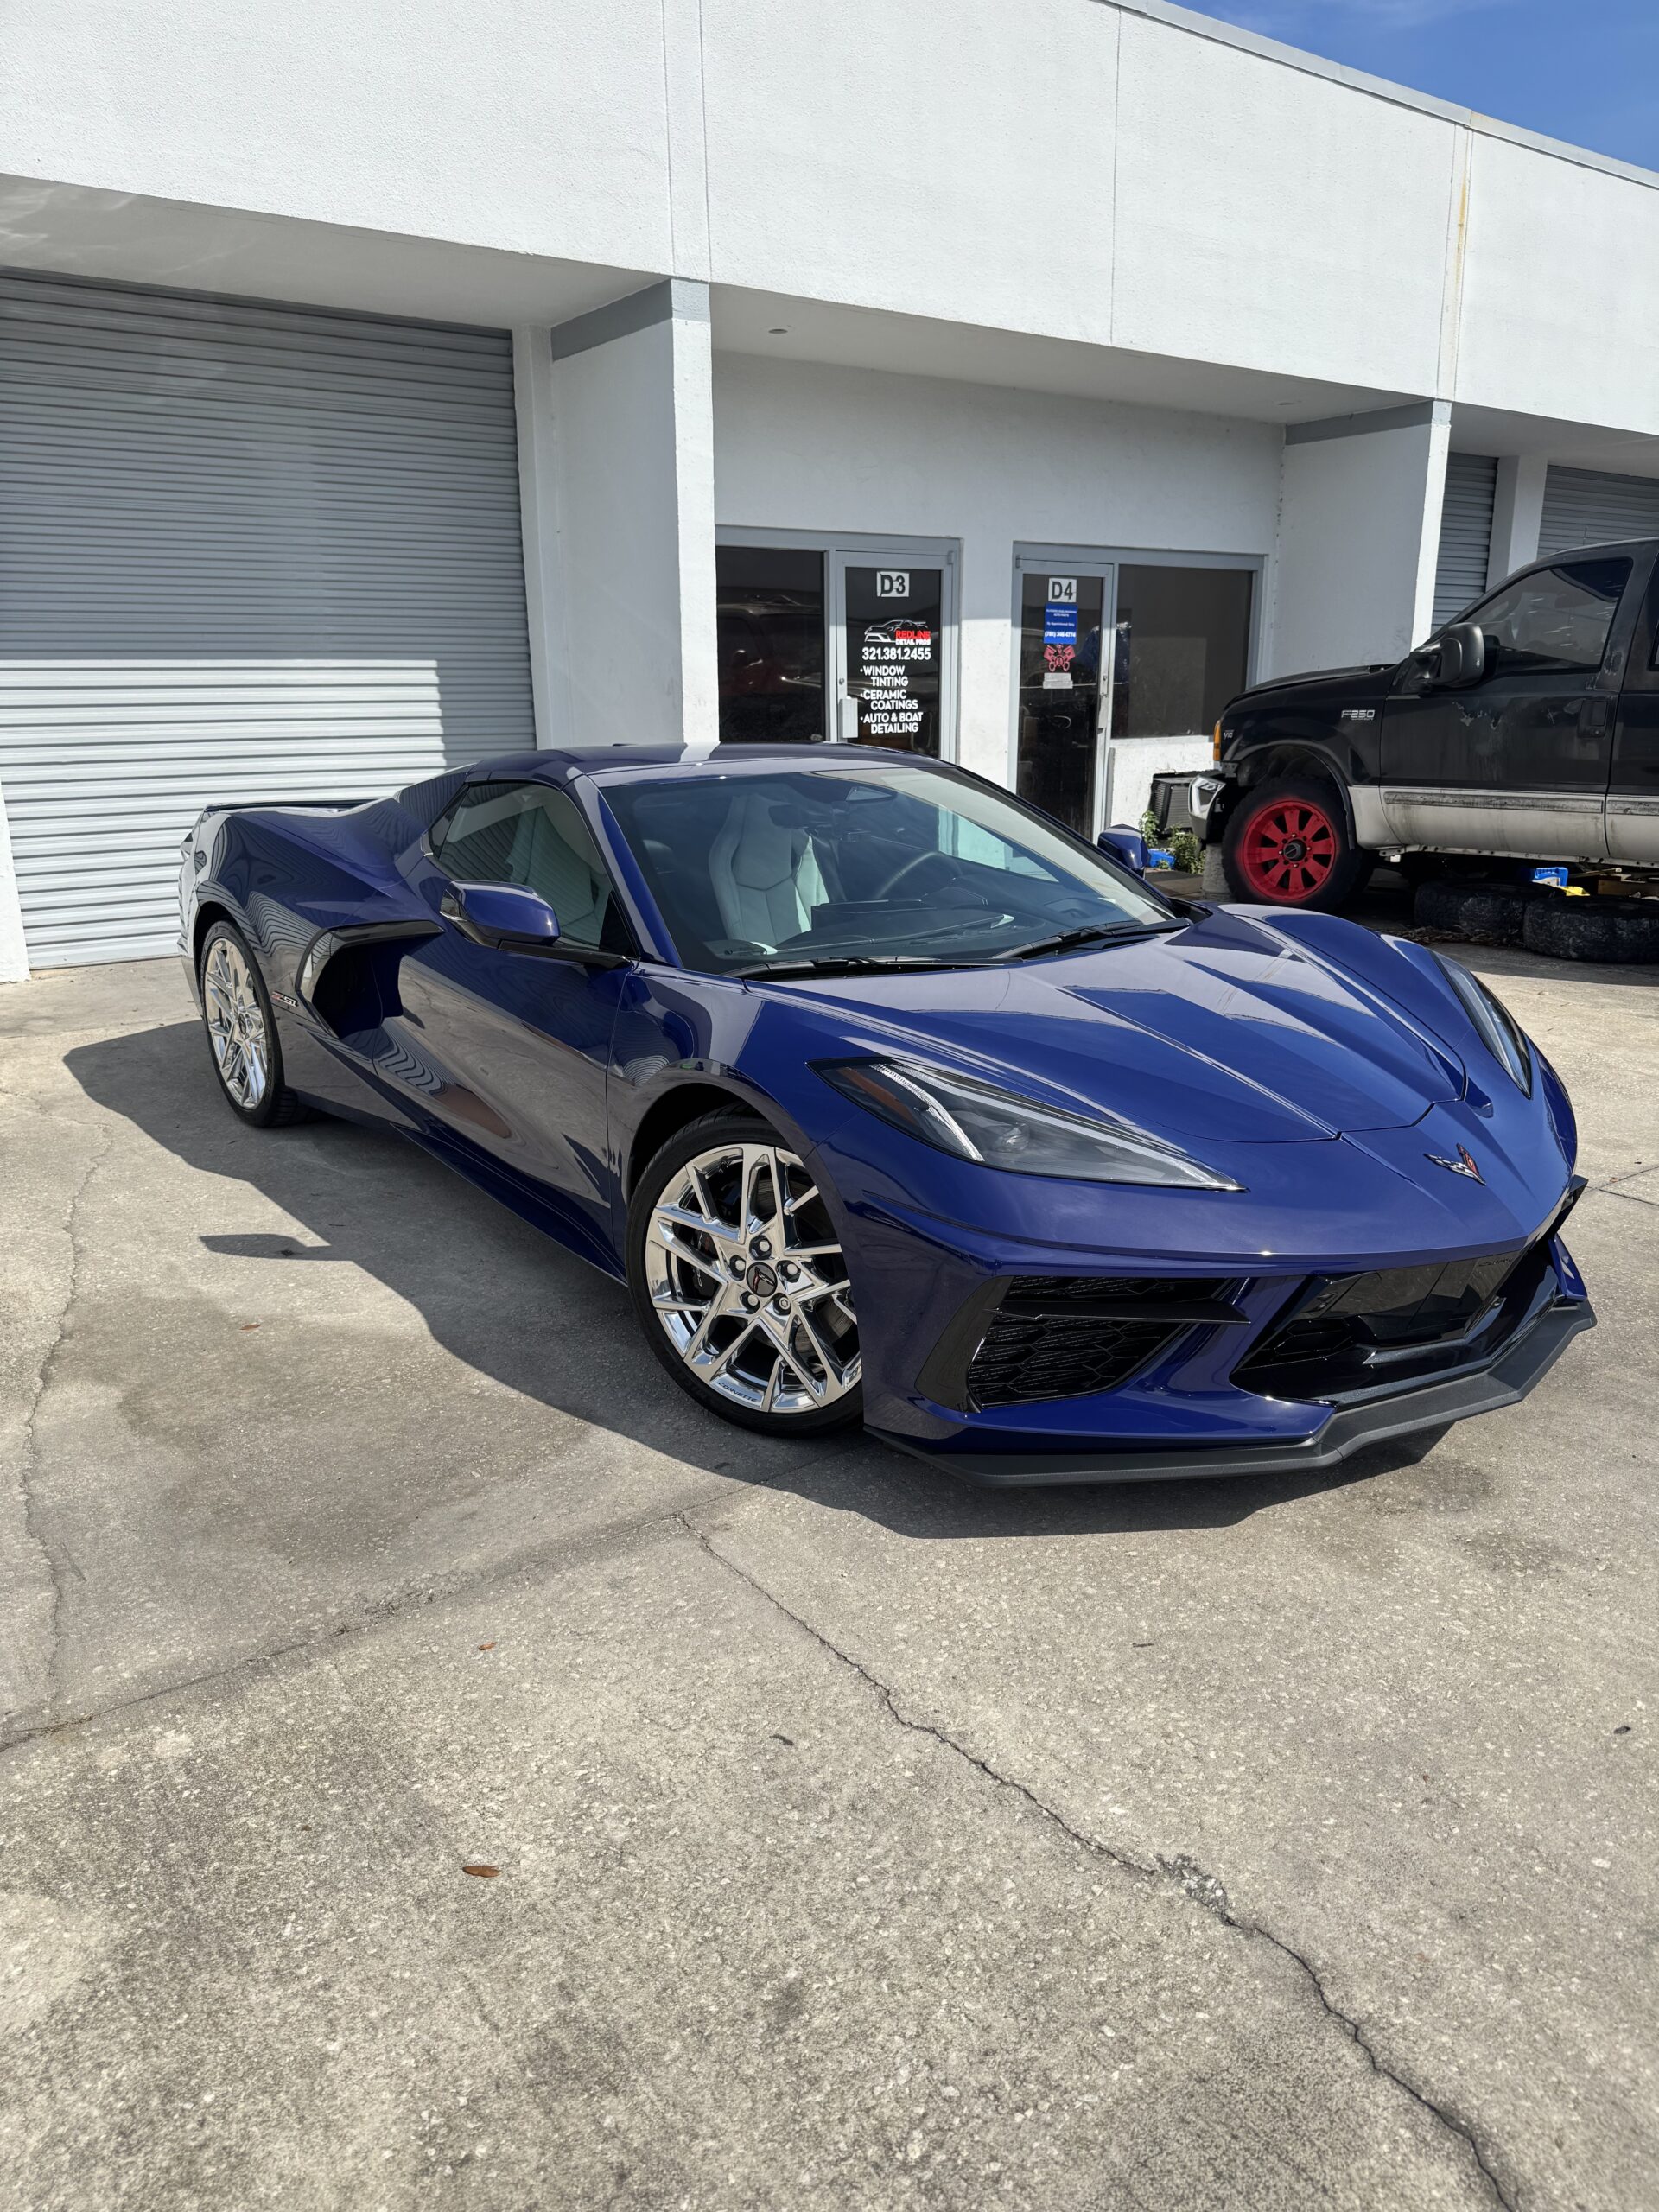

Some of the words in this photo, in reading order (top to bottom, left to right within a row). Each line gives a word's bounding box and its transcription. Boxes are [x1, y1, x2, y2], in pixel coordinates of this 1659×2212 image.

[880, 574, 906, 595] D3
[1052, 581, 1073, 601] D4
[895, 630, 931, 640] REDLINE
[861, 646, 931, 661] 321.381.2455
[870, 675, 909, 687] TINTING
[870, 699, 918, 711] COATINGS
[890, 712, 898, 723] &
[899, 711, 924, 722] BOAT
[870, 722, 919, 734] DETAILING
[718, 1382, 759, 1402] CORVETTE
